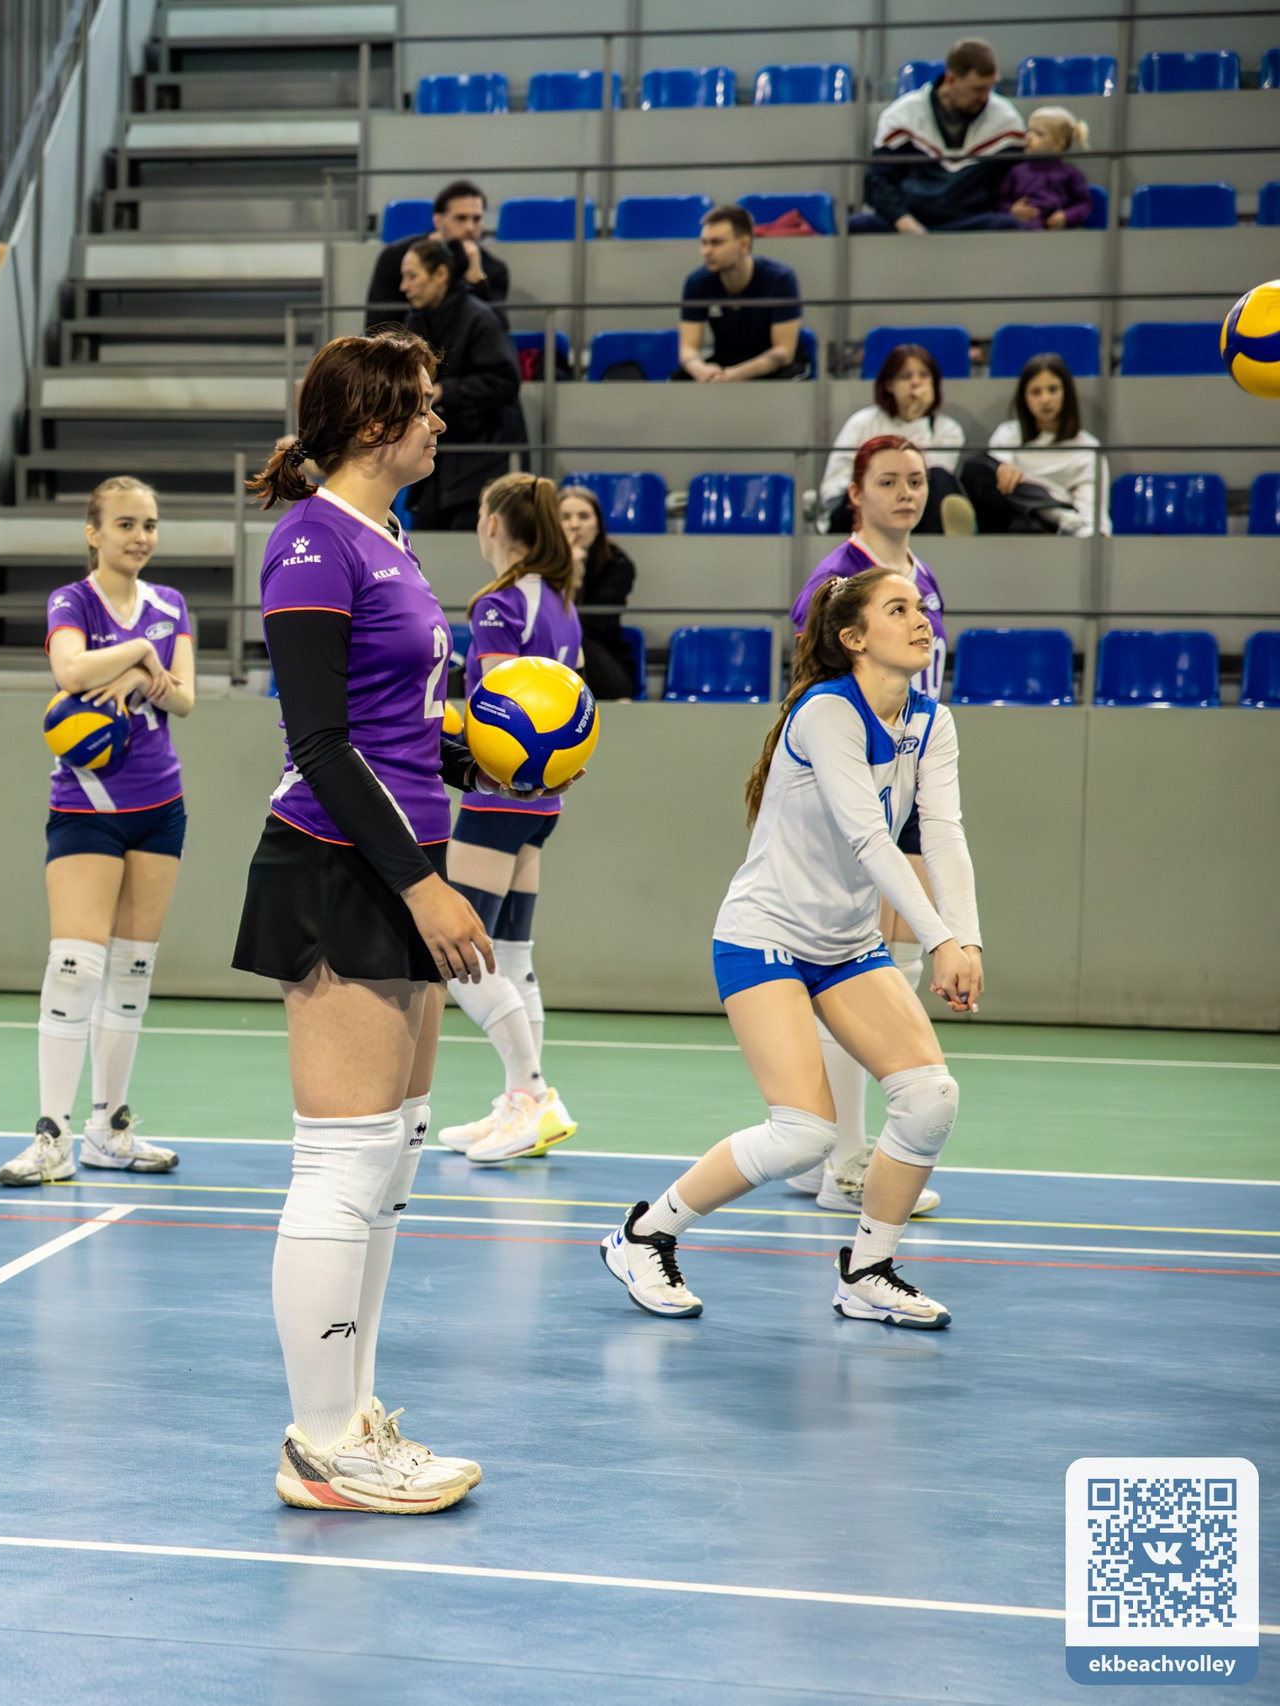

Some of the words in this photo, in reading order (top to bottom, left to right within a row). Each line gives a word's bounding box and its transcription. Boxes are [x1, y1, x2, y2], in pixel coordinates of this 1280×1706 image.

[283, 555, 322, 566] KELME
[373, 566, 401, 580] KELME
[423, 624, 449, 719] 2
